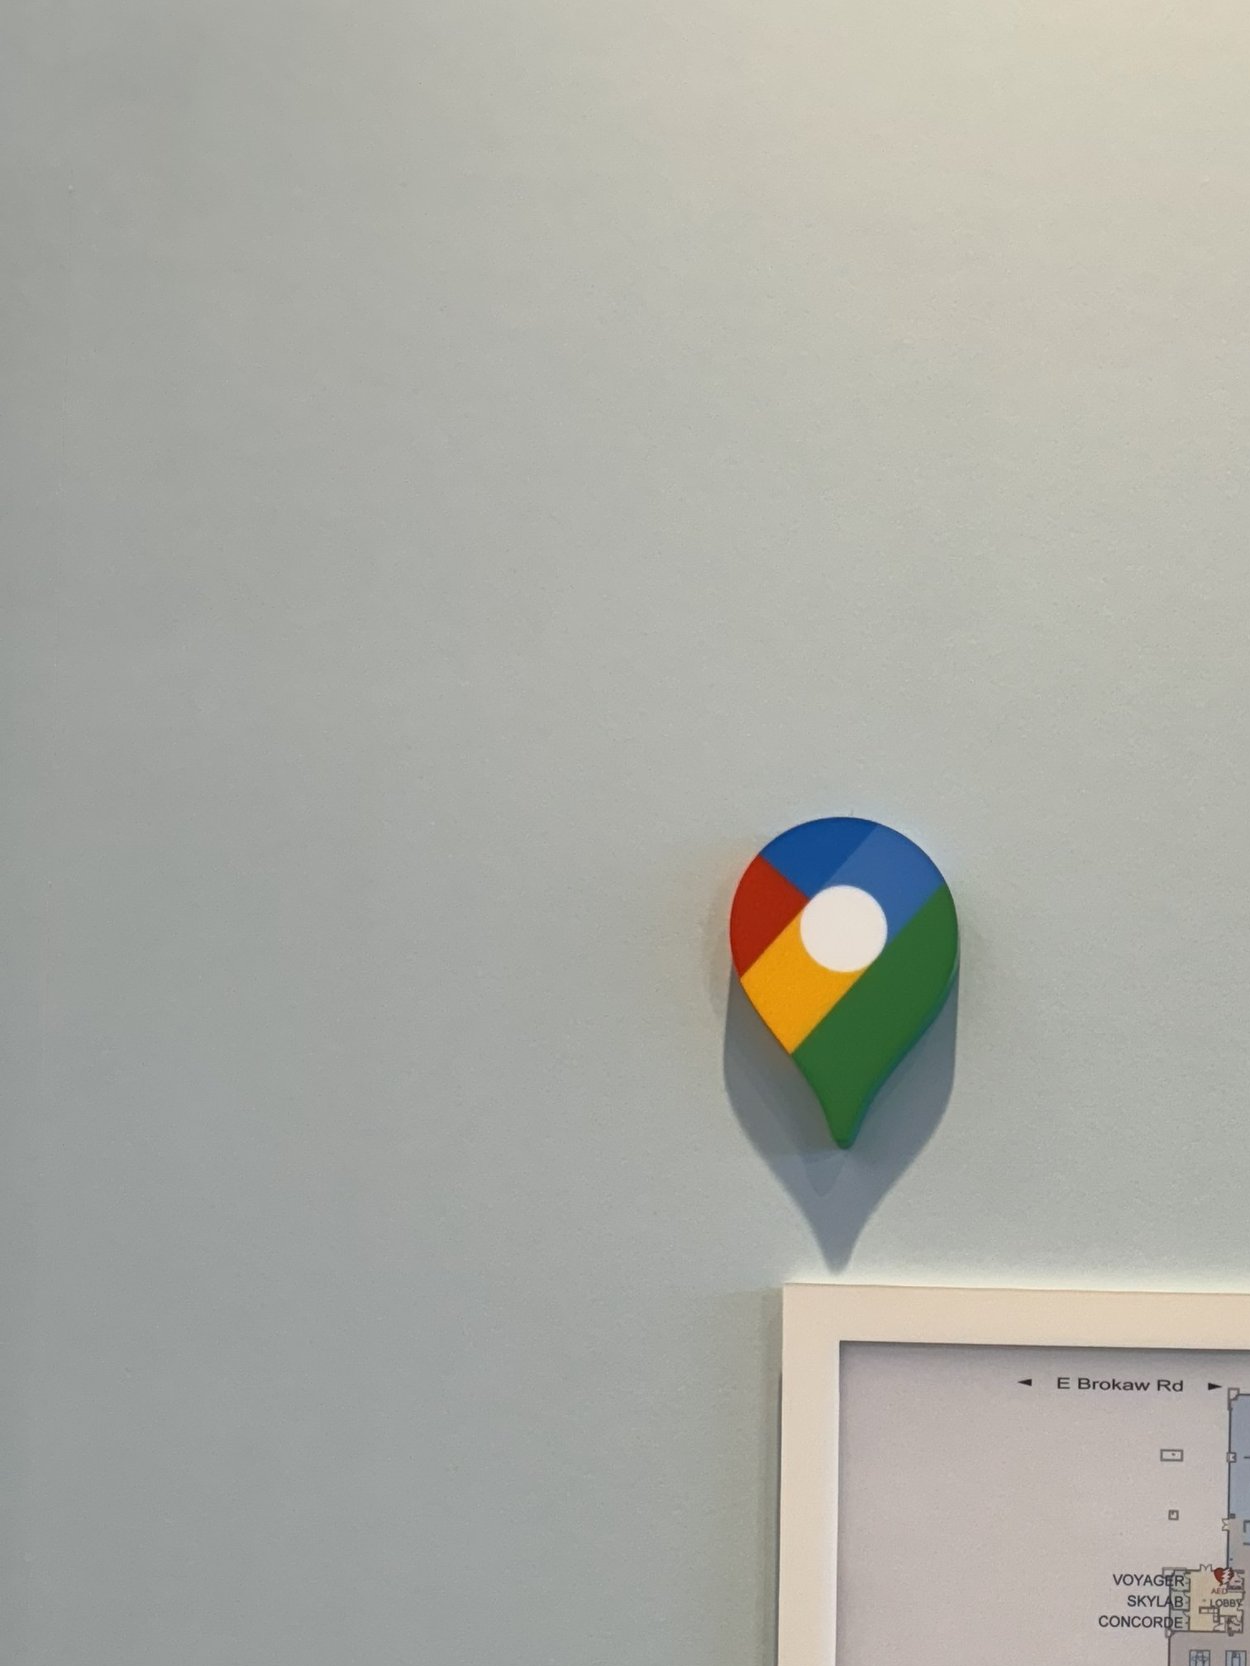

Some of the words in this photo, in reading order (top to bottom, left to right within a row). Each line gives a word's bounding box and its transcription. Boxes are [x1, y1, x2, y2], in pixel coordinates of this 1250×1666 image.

[1057, 1377, 1071, 1390] E
[1077, 1377, 1151, 1392] Brokaw
[1157, 1379, 1184, 1392] Rd
[1112, 1573, 1185, 1587] VOYAGER
[1211, 1587, 1227, 1595] AED
[1127, 1595, 1184, 1608] SKYLAB
[1209, 1598, 1242, 1608] LOBBY
[1098, 1615, 1183, 1629] CONCORDE
